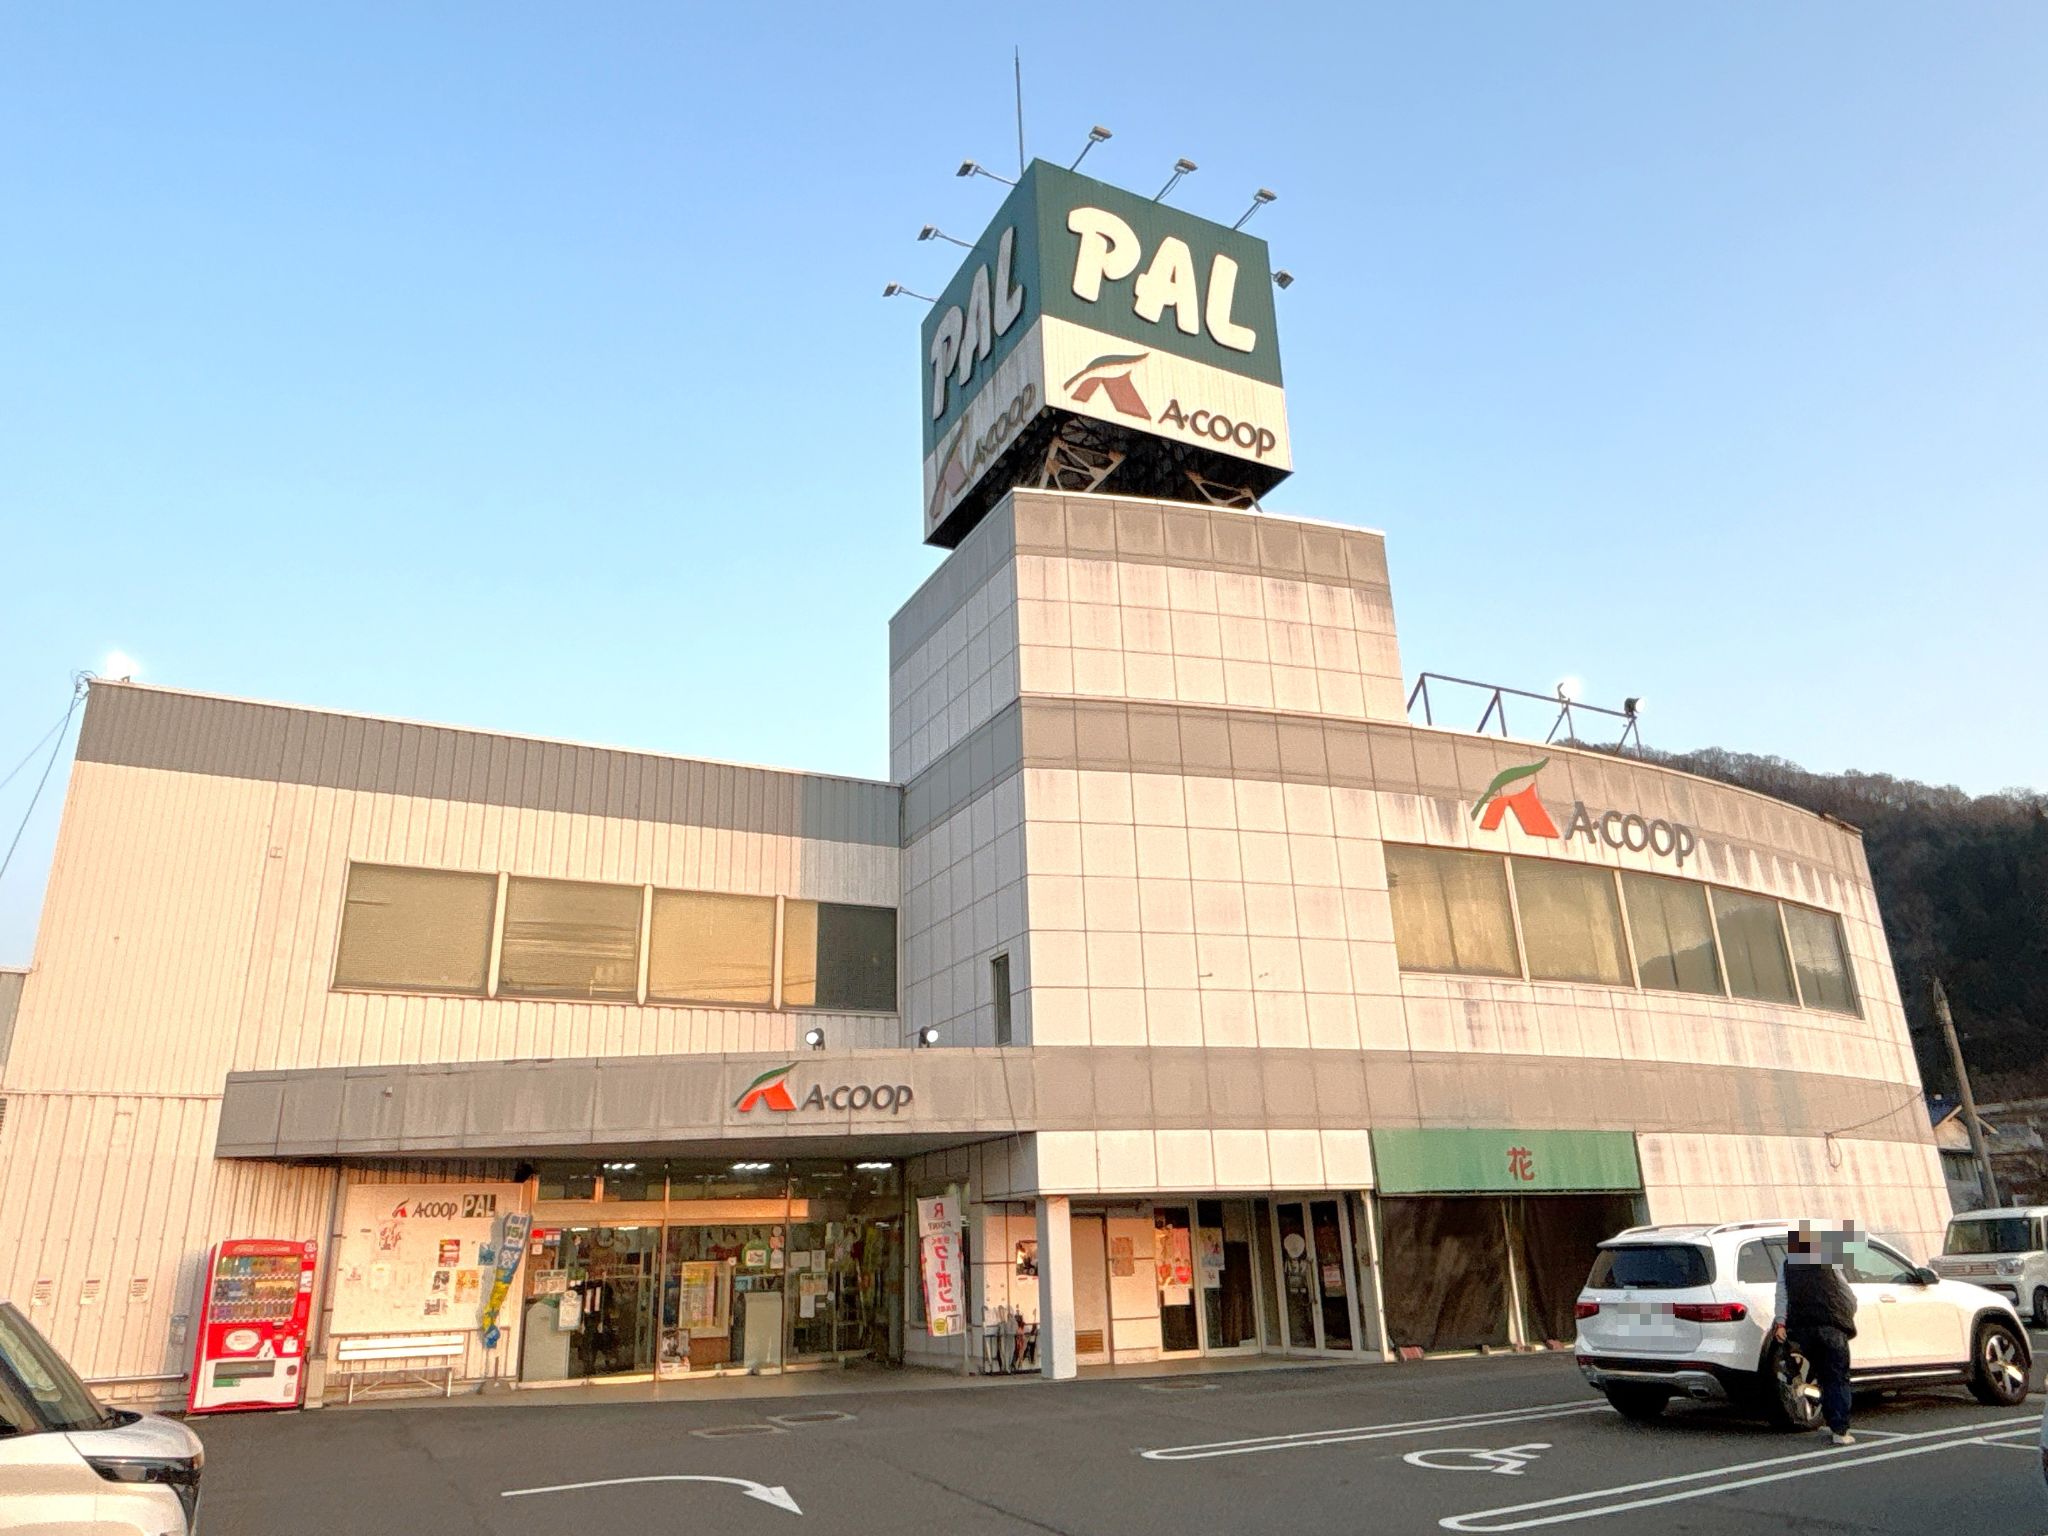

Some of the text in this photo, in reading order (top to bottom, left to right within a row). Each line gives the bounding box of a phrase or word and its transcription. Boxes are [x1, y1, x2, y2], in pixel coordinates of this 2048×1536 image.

[931, 226, 1023, 421] PAL
[1066, 206, 1257, 353] PAL
[461, 1194, 497, 1218] PAL
[1505, 1145, 1536, 1181] 花
